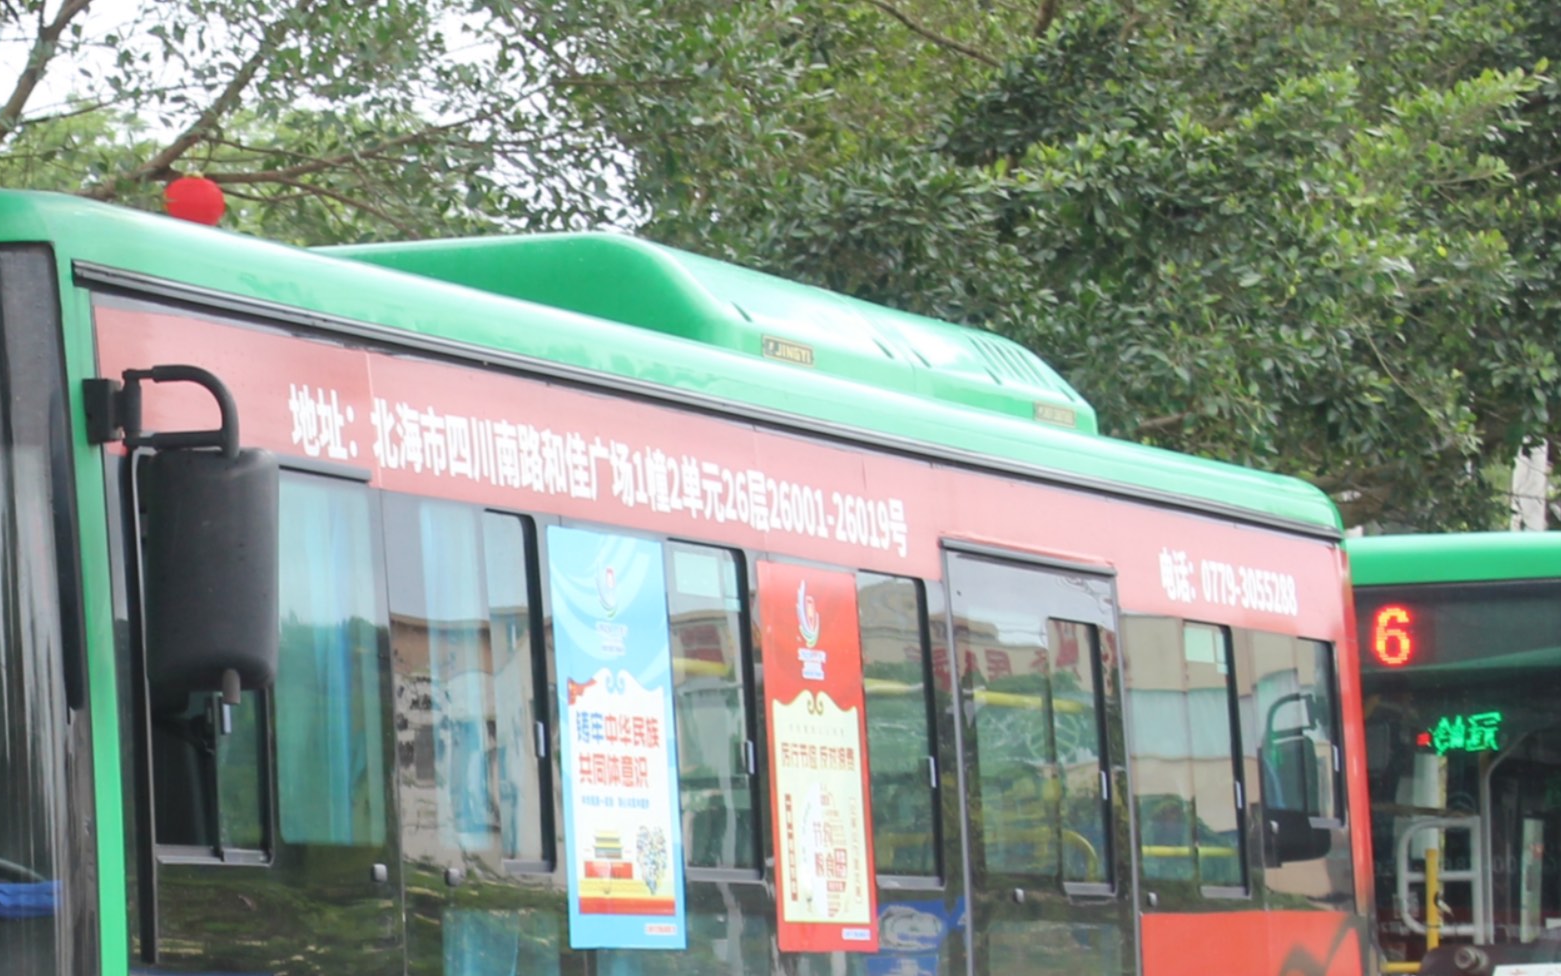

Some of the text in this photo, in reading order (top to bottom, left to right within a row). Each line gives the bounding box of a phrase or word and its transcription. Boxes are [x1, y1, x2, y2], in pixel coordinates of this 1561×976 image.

[1374, 607, 1411, 665] 6
[576, 710, 659, 748] 铸牢中华民族
[579, 752, 648, 788] 共同体意识
